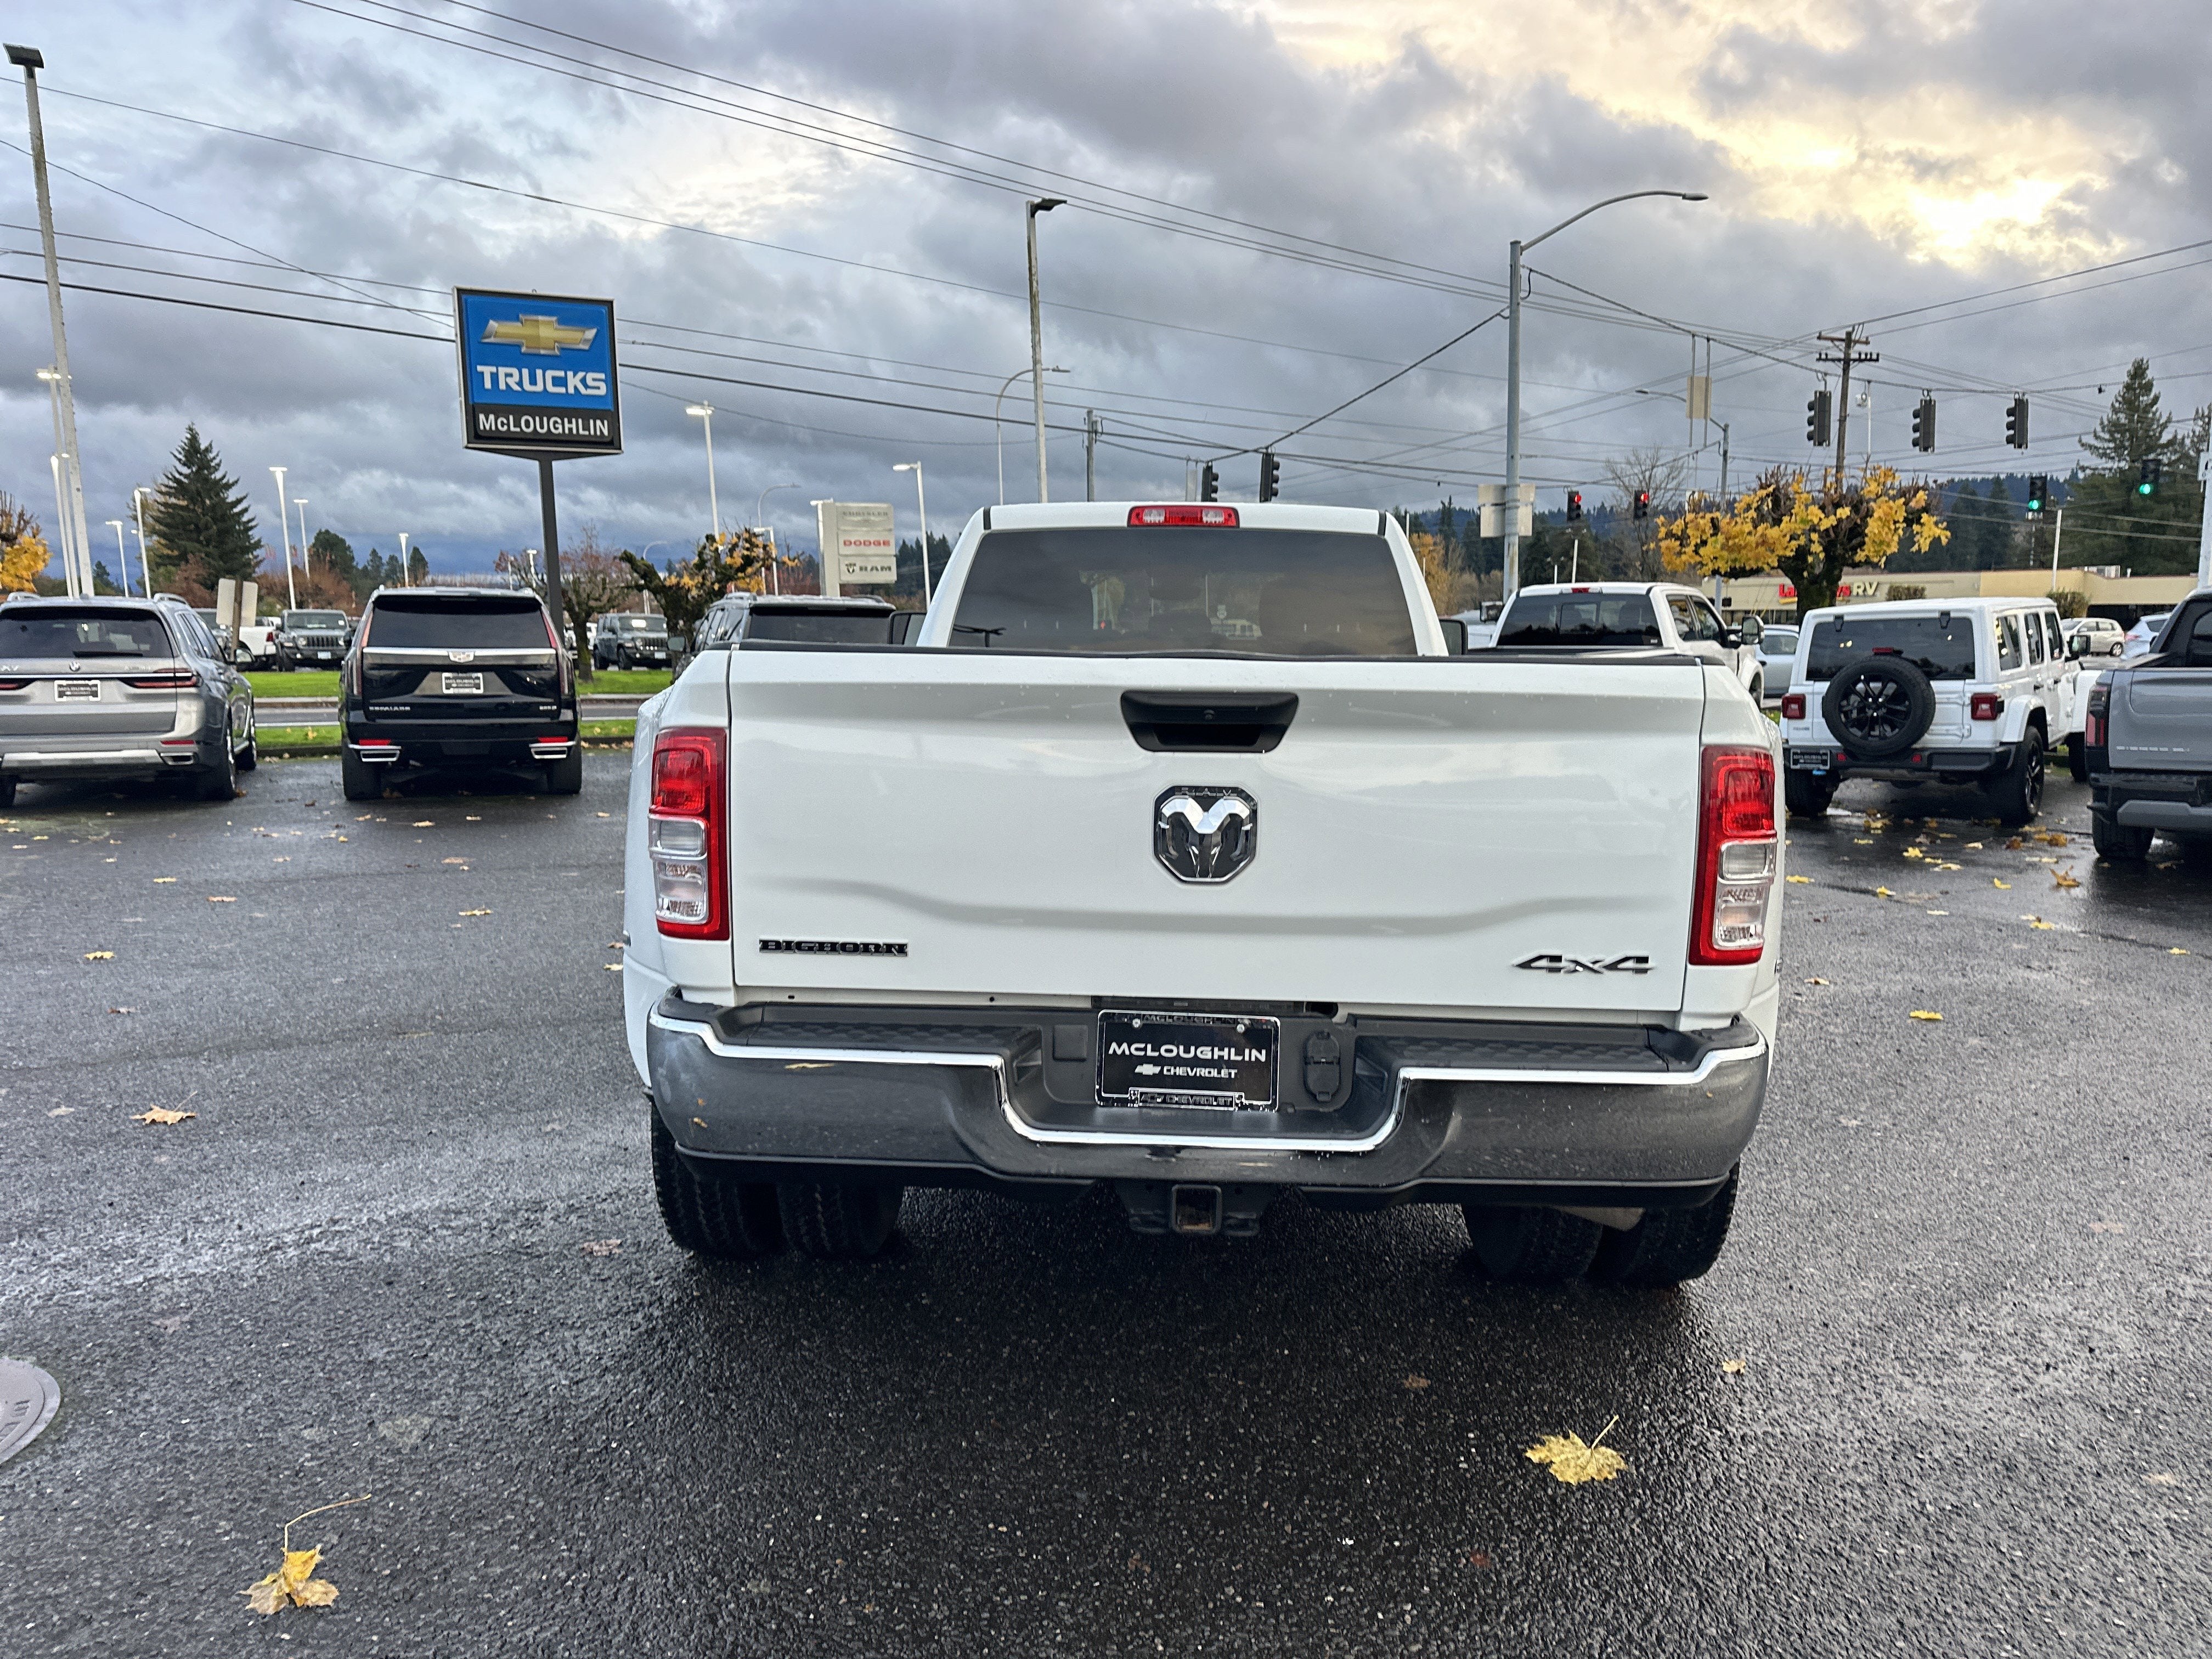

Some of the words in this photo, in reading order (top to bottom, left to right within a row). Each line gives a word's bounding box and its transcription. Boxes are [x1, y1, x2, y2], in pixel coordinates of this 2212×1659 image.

[477, 365, 606, 396] TRUCKS
[478, 413, 608, 436] McLOUGHLIN
[1853, 580, 1878, 596] RV
[1108, 1042, 1266, 1063] MCLOUGHLIN
[1163, 1065, 1238, 1079] CHEVROLET
[1166, 1094, 1233, 1106] CHEVROLET
